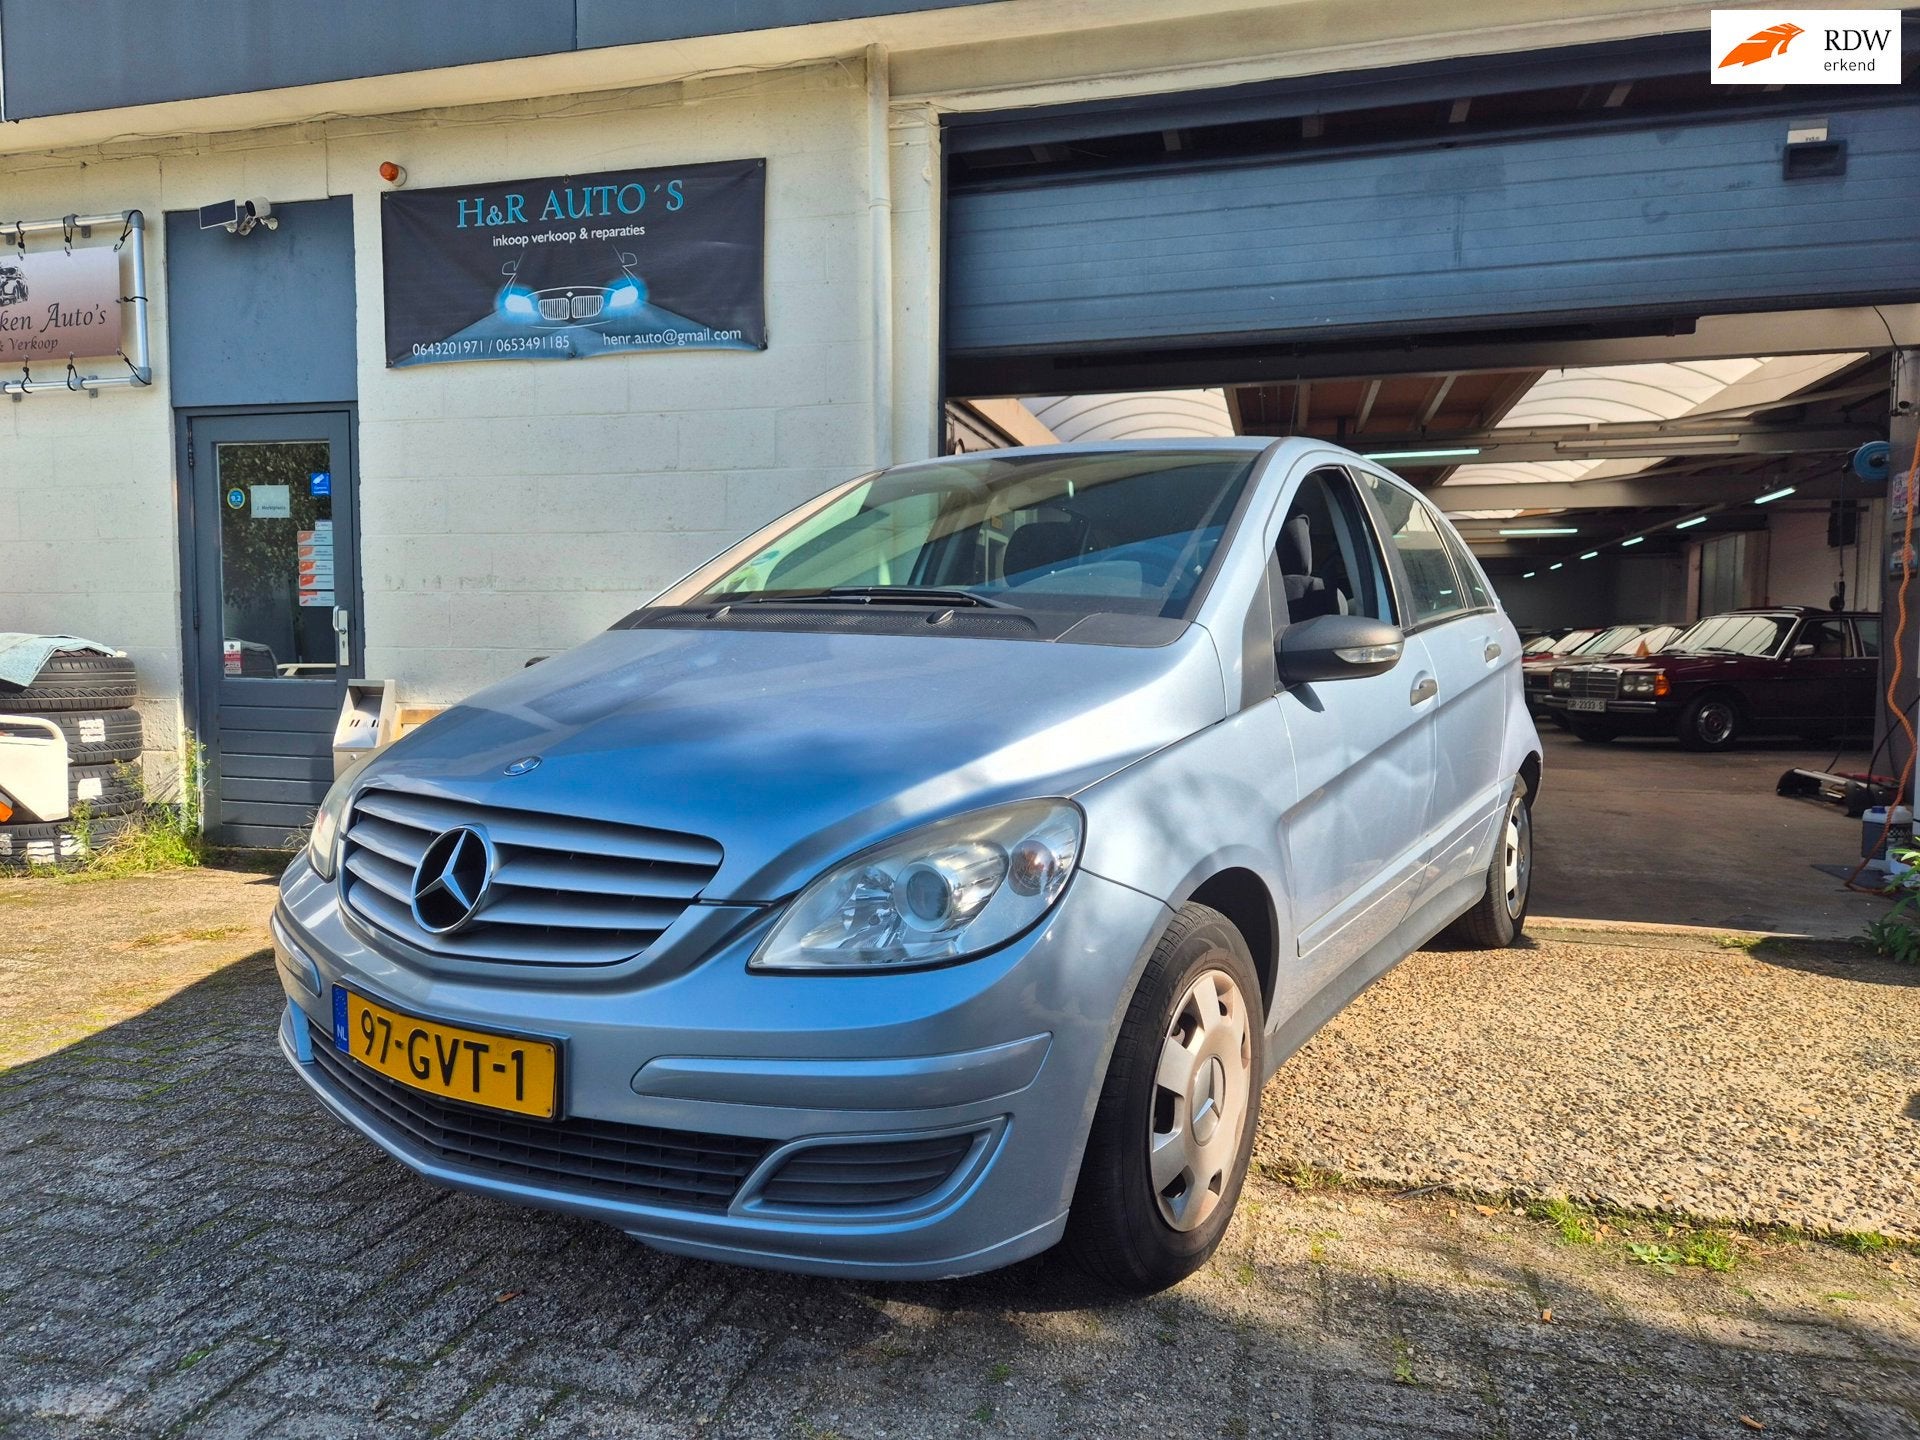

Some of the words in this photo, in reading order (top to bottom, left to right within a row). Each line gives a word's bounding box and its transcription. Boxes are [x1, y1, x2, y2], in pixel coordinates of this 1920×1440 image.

[456, 194, 528, 228] H&R
[493, 235, 529, 247] inkoop
[531, 230, 577, 244] verkoop
[579, 227, 588, 239] &
[591, 225, 646, 240] reparaties
[40, 302, 107, 333] Auto's
[9, 336, 58, 353] Verkoop
[412, 340, 483, 356] 0643201971
[496, 335, 570, 352] 0653491185
[603, 328, 742, 346] henr.auto@gmail.com
[336, 1026, 348, 1042] NL
[360, 1007, 524, 1101] 97-GVT-1
